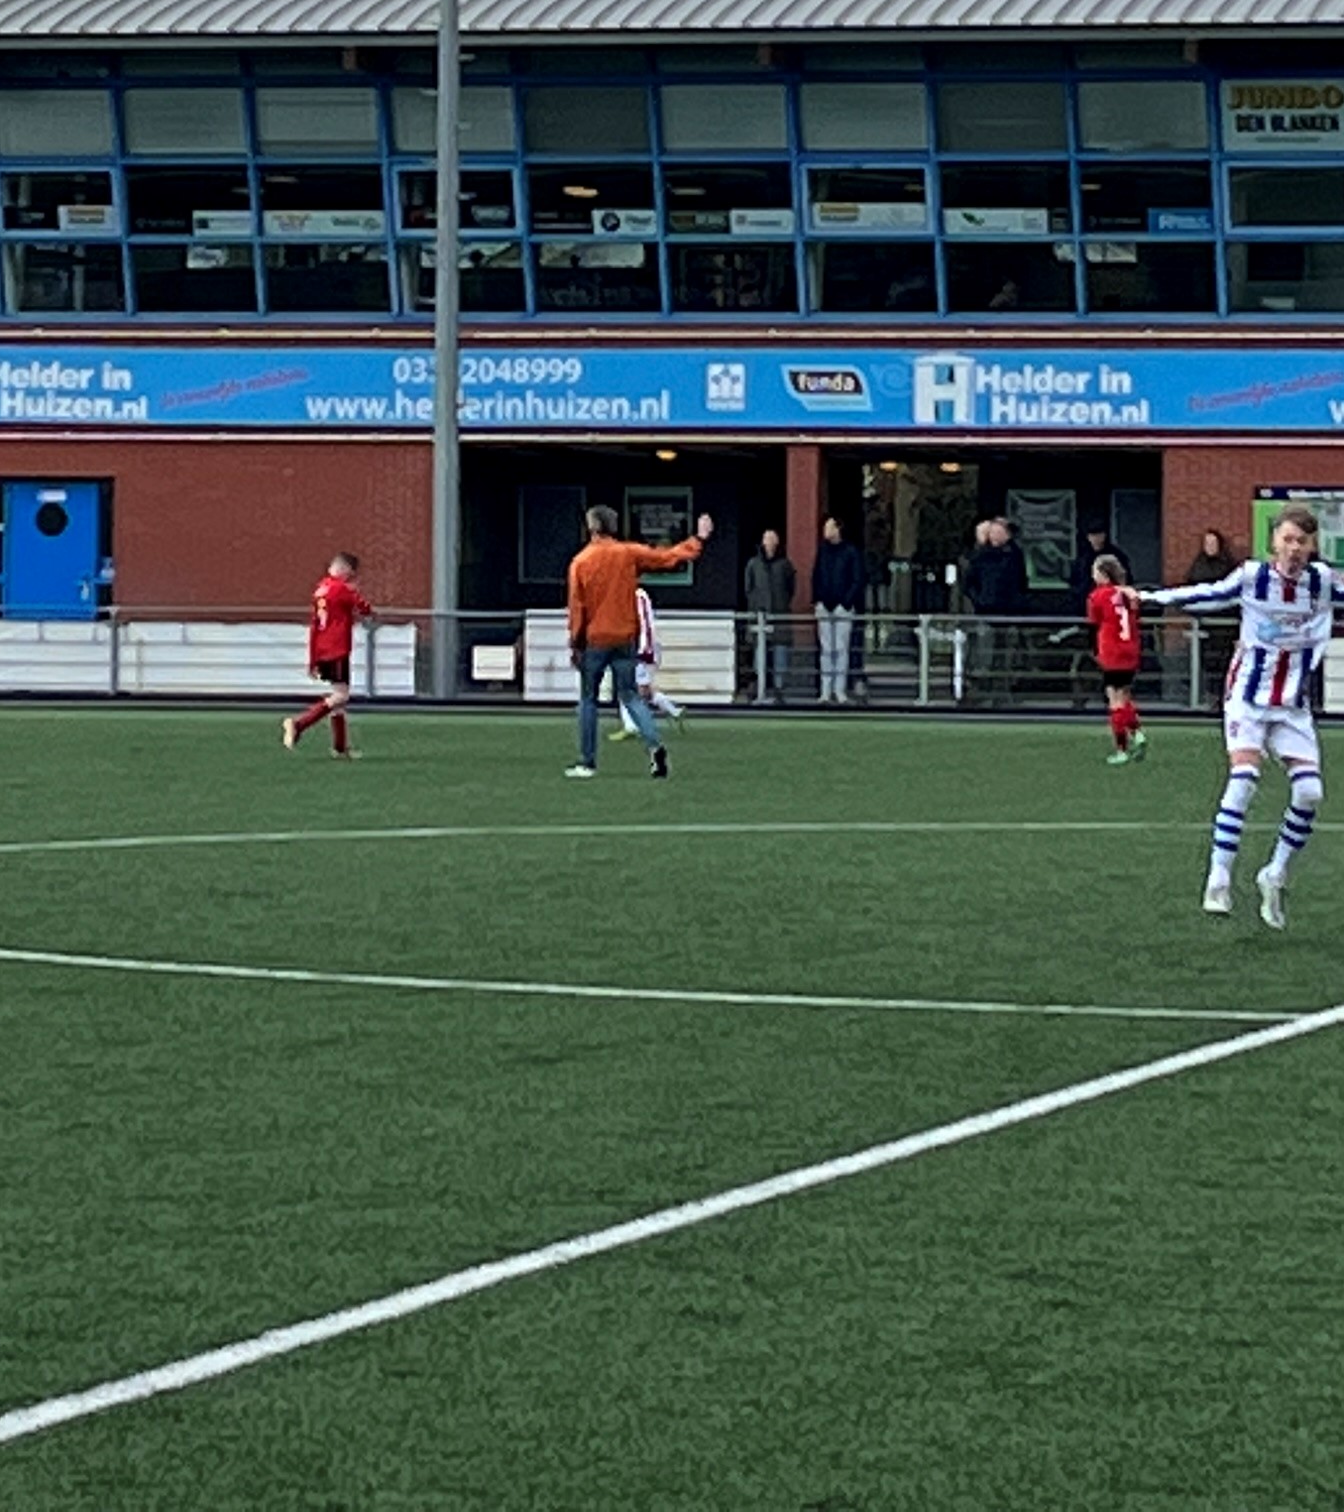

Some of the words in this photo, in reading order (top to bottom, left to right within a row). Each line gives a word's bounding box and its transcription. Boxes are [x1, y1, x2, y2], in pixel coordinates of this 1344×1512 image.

[101, 361, 131, 390] in
[796, 373, 856, 392] funda
[976, 364, 1092, 393] Helder
[1099, 364, 1132, 393] in
[0, 390, 147, 420] Huizen.nl
[306, 389, 670, 421] www.heerinhuizen.nl
[991, 395, 1150, 425] Huizen.nl
